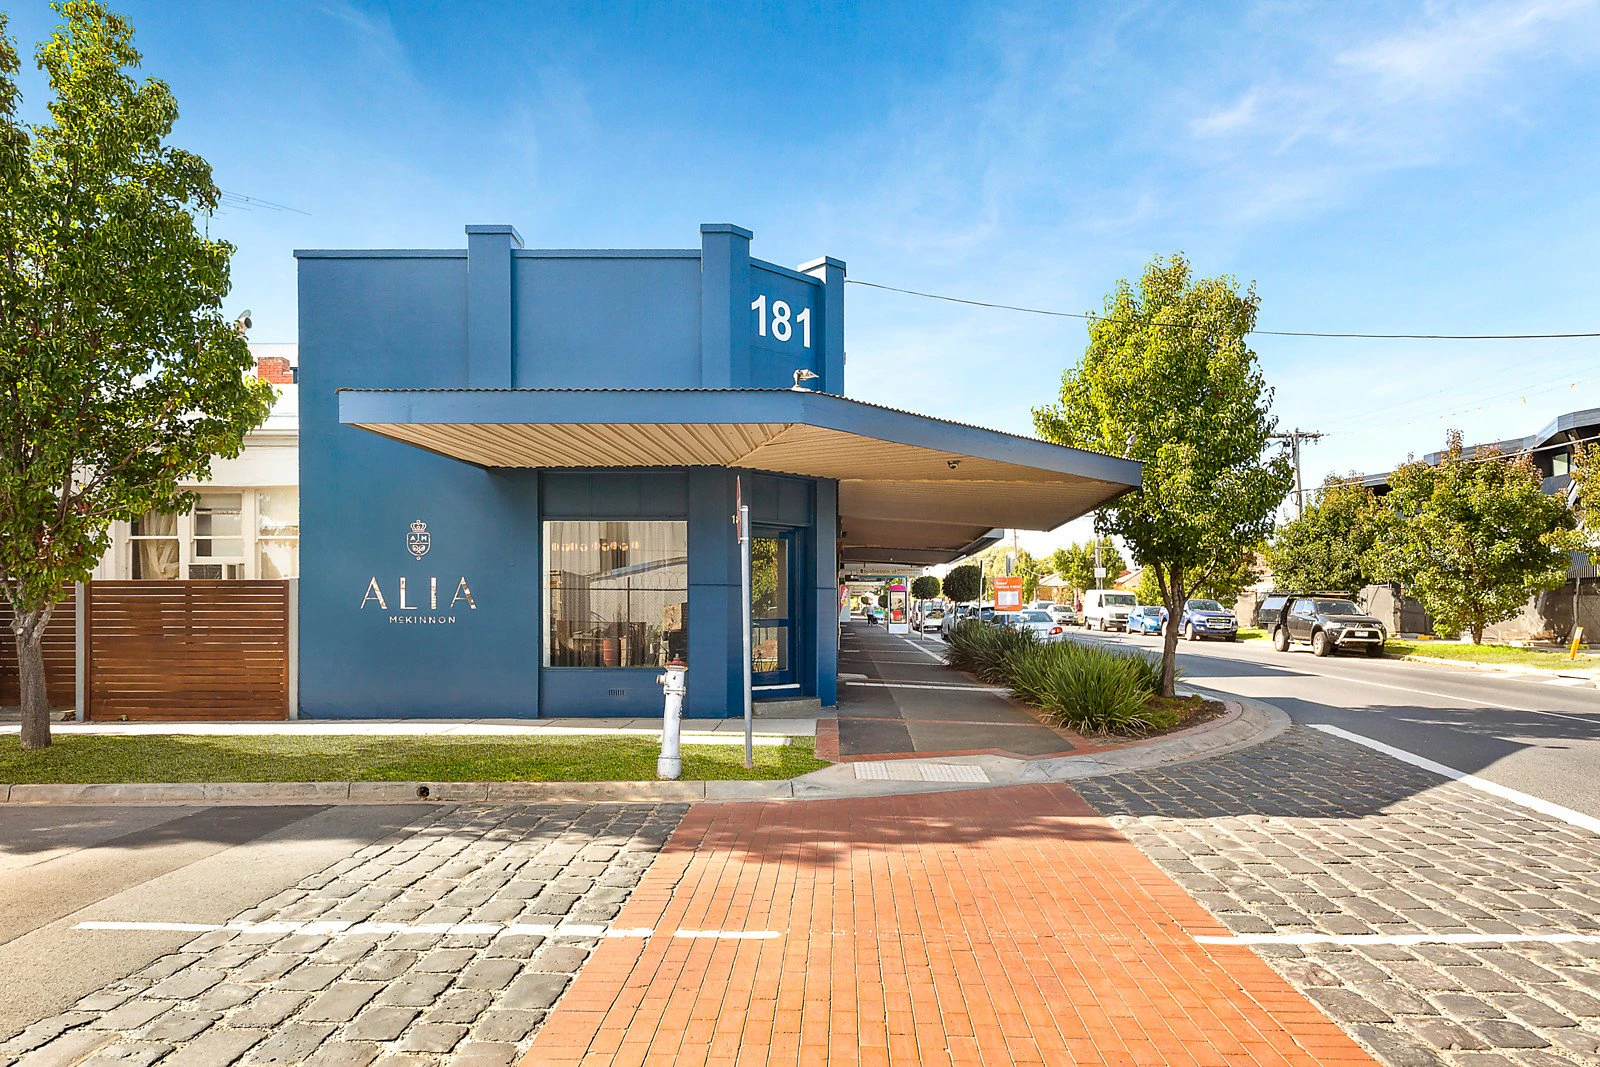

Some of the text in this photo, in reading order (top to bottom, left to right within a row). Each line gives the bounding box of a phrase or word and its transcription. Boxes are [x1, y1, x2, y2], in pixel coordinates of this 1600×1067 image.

[751, 294, 811, 349] 181
[360, 576, 477, 610] ALIA
[389, 616, 456, 624] McKINNON
